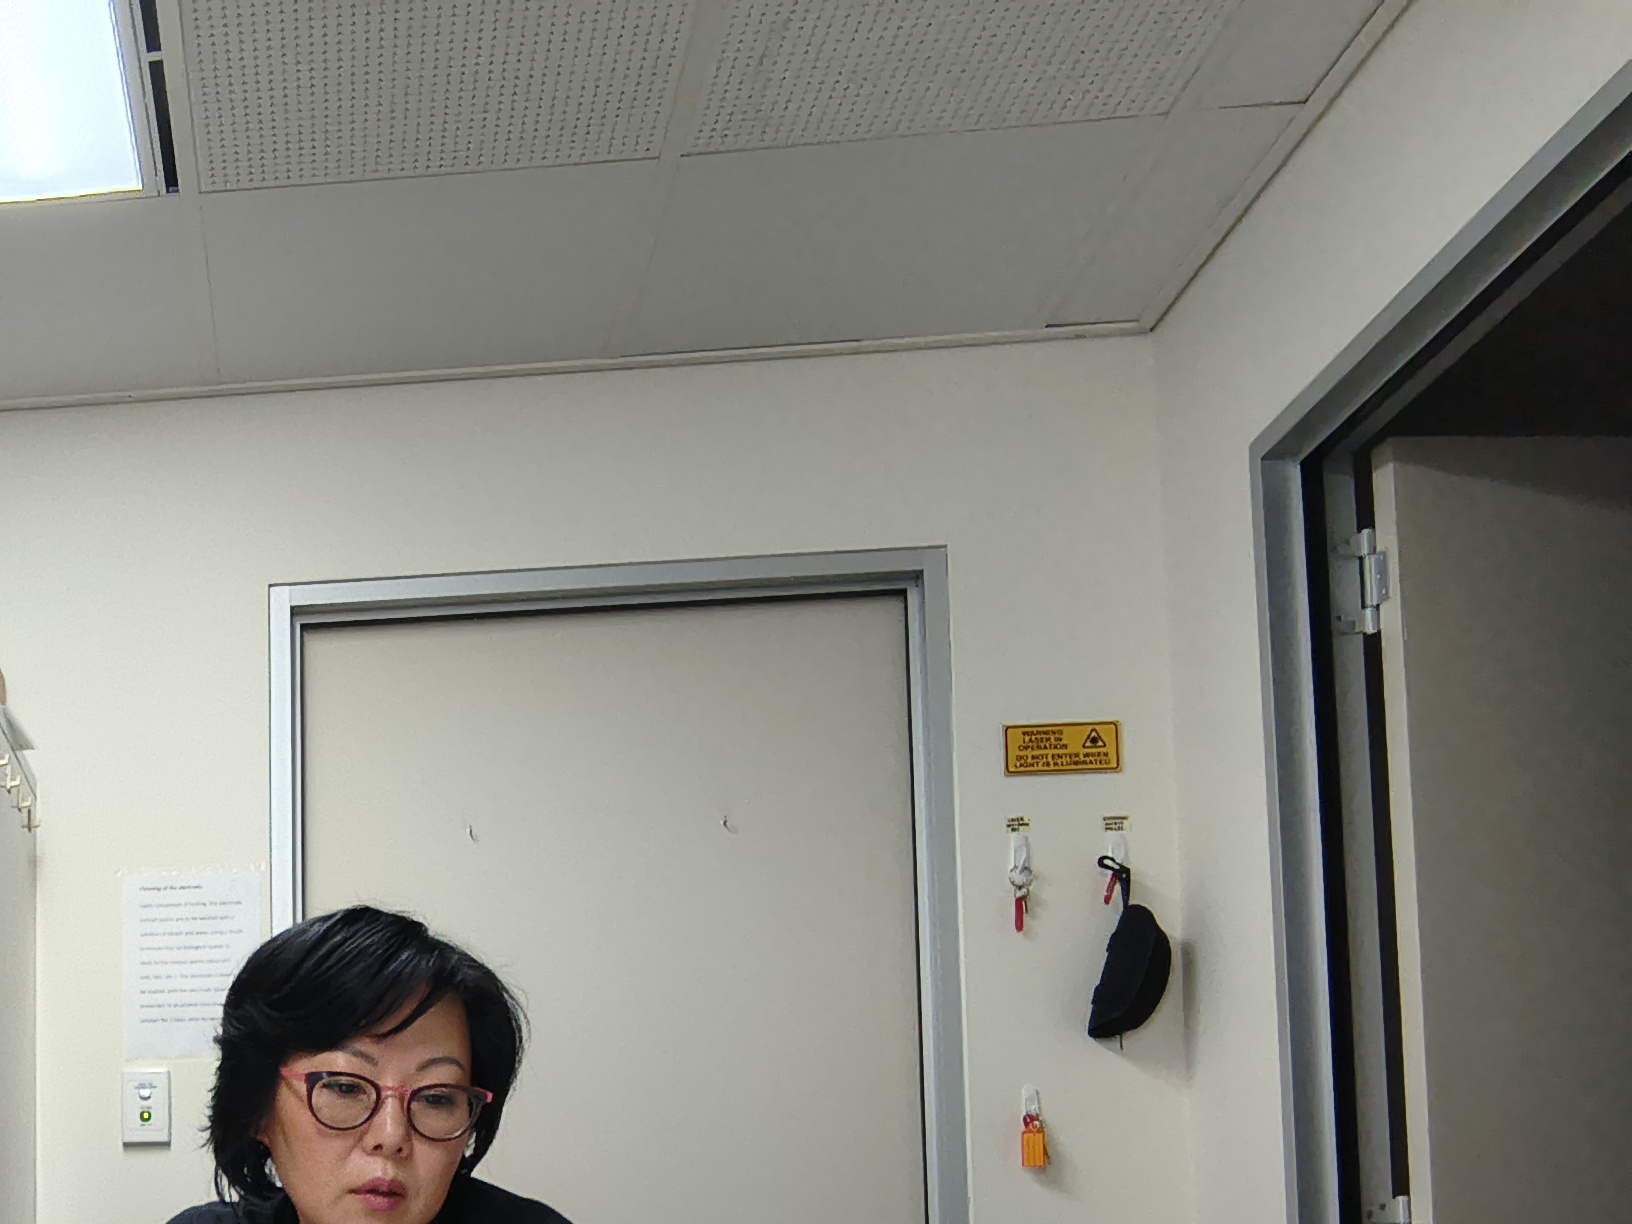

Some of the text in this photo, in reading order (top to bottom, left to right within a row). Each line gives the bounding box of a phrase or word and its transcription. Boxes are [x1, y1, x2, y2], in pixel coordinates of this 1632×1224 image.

[1021, 729, 1064, 737] WARNING
[1018, 744, 1068, 752] OPERATION
[1015, 751, 1109, 762] DO NOT ENTER WHEN
